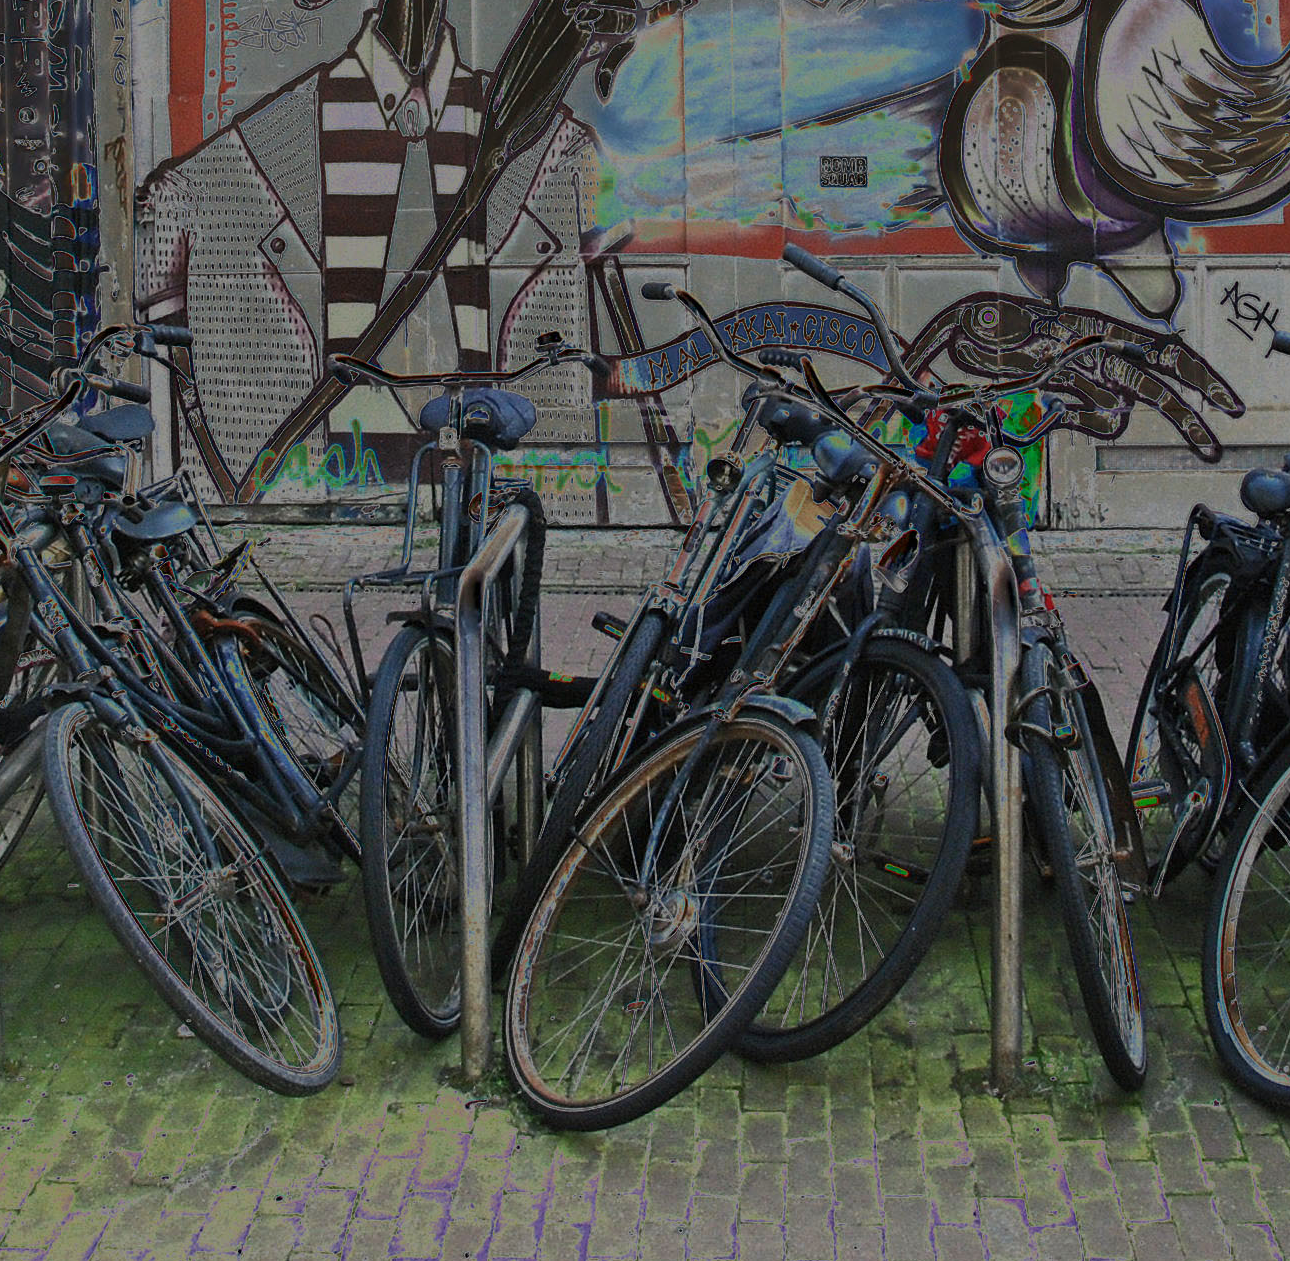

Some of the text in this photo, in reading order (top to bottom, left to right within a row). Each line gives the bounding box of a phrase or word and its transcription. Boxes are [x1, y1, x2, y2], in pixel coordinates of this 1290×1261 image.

[820, 172, 866, 186] SQUAD
[648, 311, 877, 385] MALKKAI CISCO
